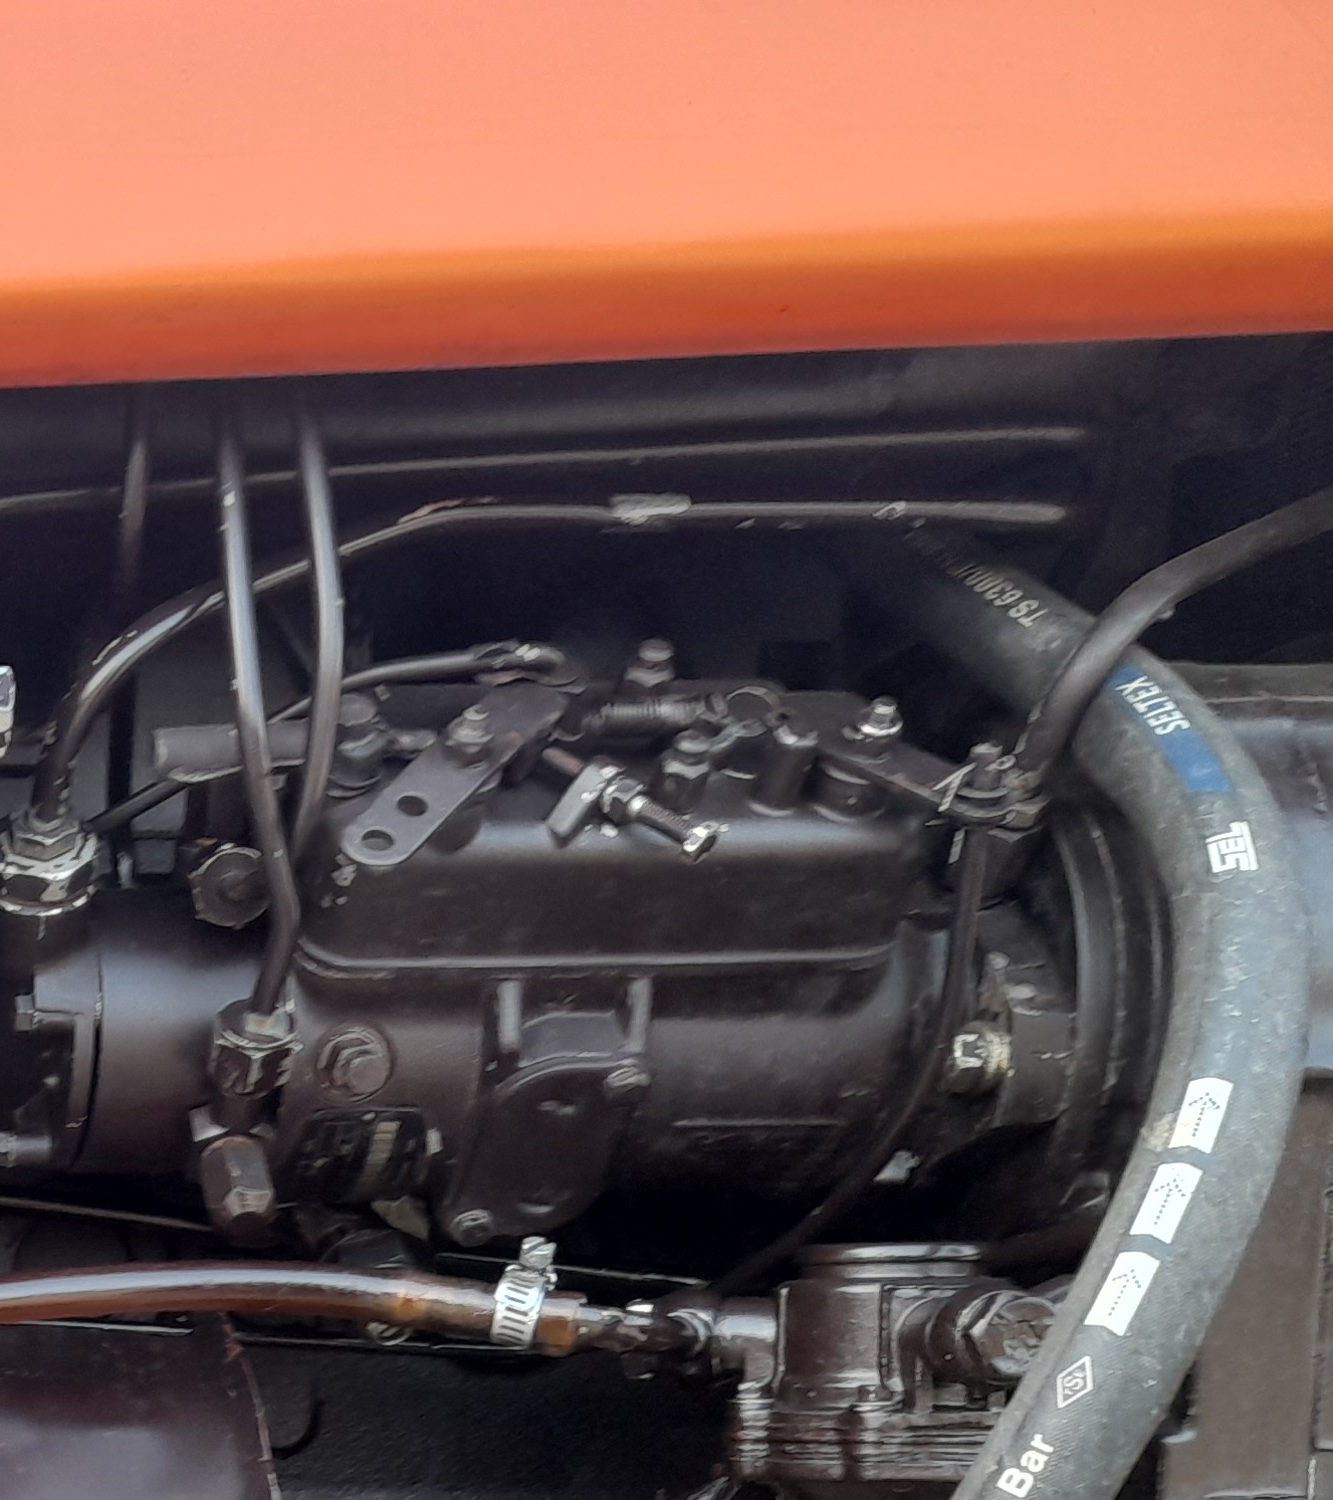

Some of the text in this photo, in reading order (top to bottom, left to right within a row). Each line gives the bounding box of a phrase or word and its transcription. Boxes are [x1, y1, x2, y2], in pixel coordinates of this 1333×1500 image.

[1006, 599, 1049, 628] TS
[1114, 675, 1191, 736] SELTEX
[997, 1434, 1054, 1498] Bar
